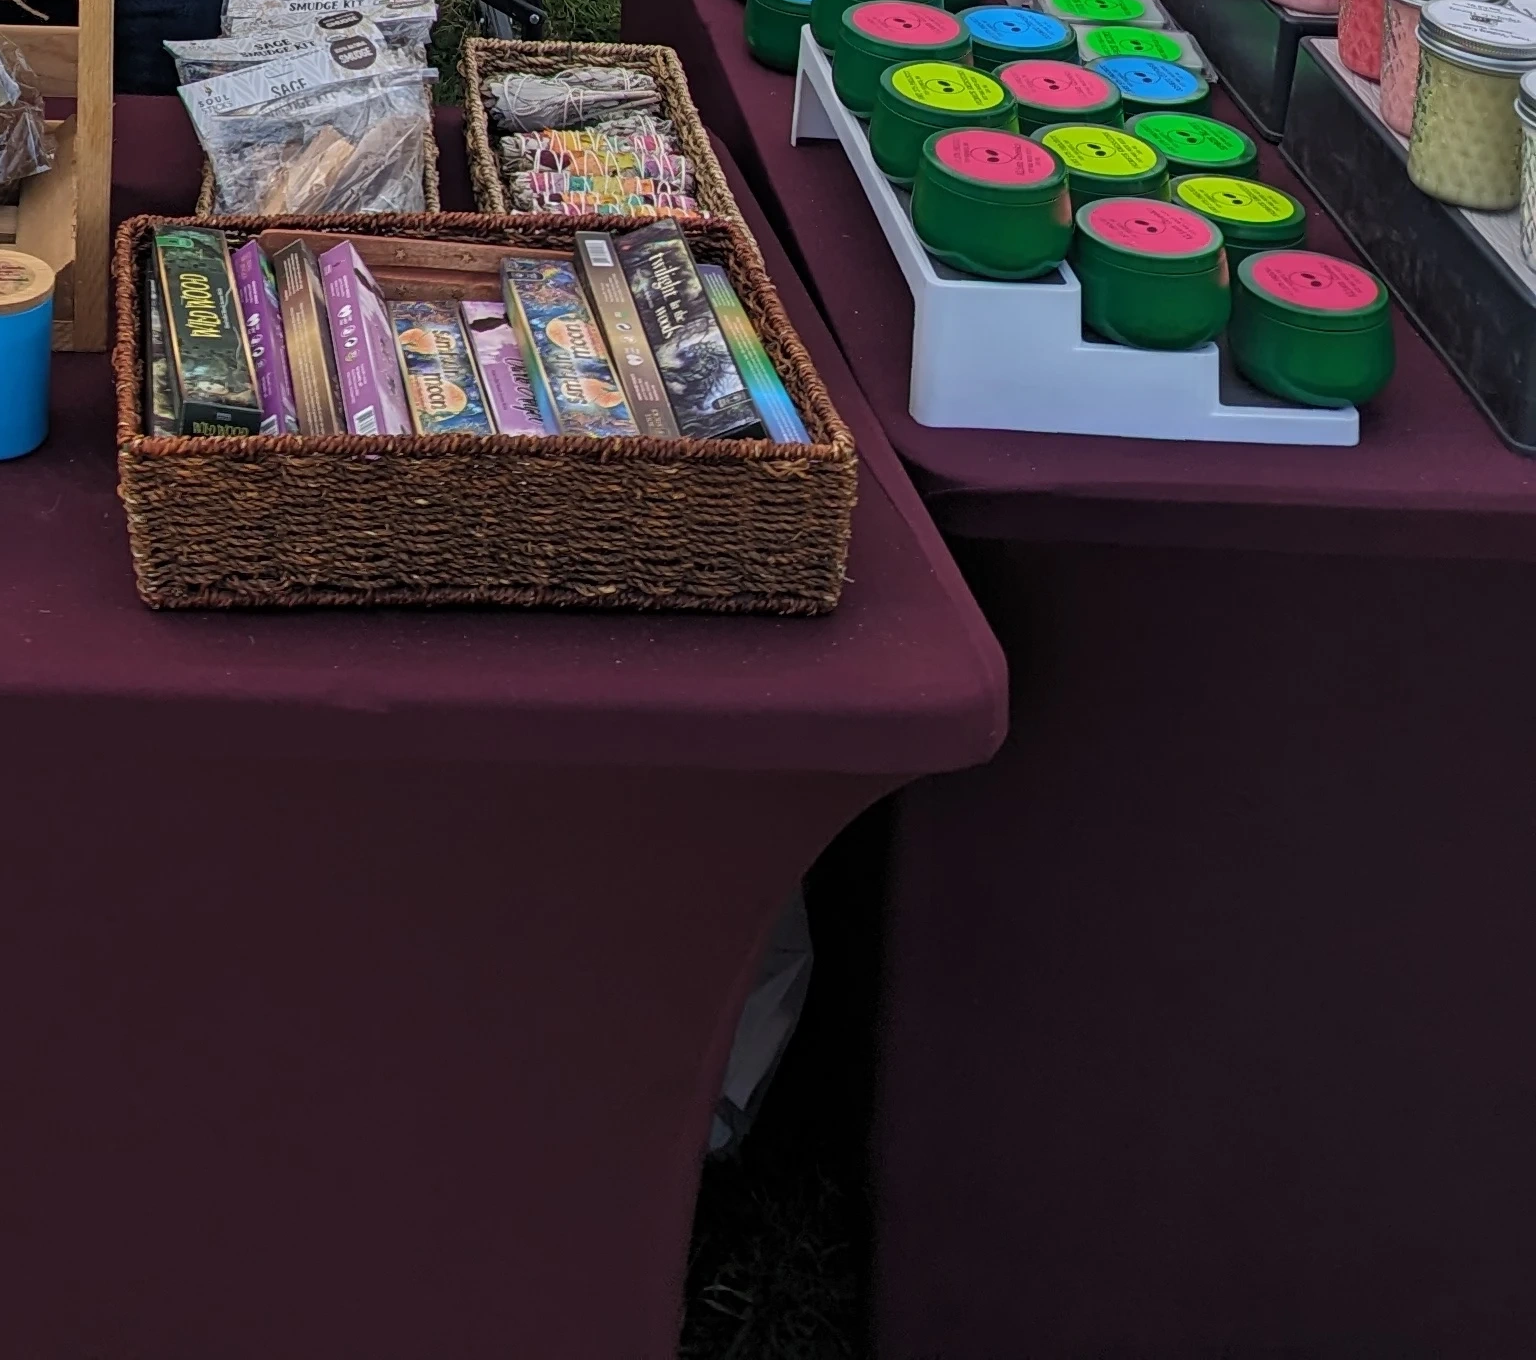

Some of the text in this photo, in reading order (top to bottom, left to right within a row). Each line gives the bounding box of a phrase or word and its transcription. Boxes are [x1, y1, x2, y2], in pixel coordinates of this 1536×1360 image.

[289, 0, 365, 12] SMUDGE KIT
[240, 41, 316, 58] SMUDGE KIT
[254, 39, 292, 51] SAGE
[338, 46, 374, 64] SMUDGE
[198, 94, 230, 108] SOUL
[648, 252, 682, 300] twilight
[180, 273, 222, 338] WILD WOOD
[654, 307, 680, 340] woods
[423, 373, 447, 410] moon
